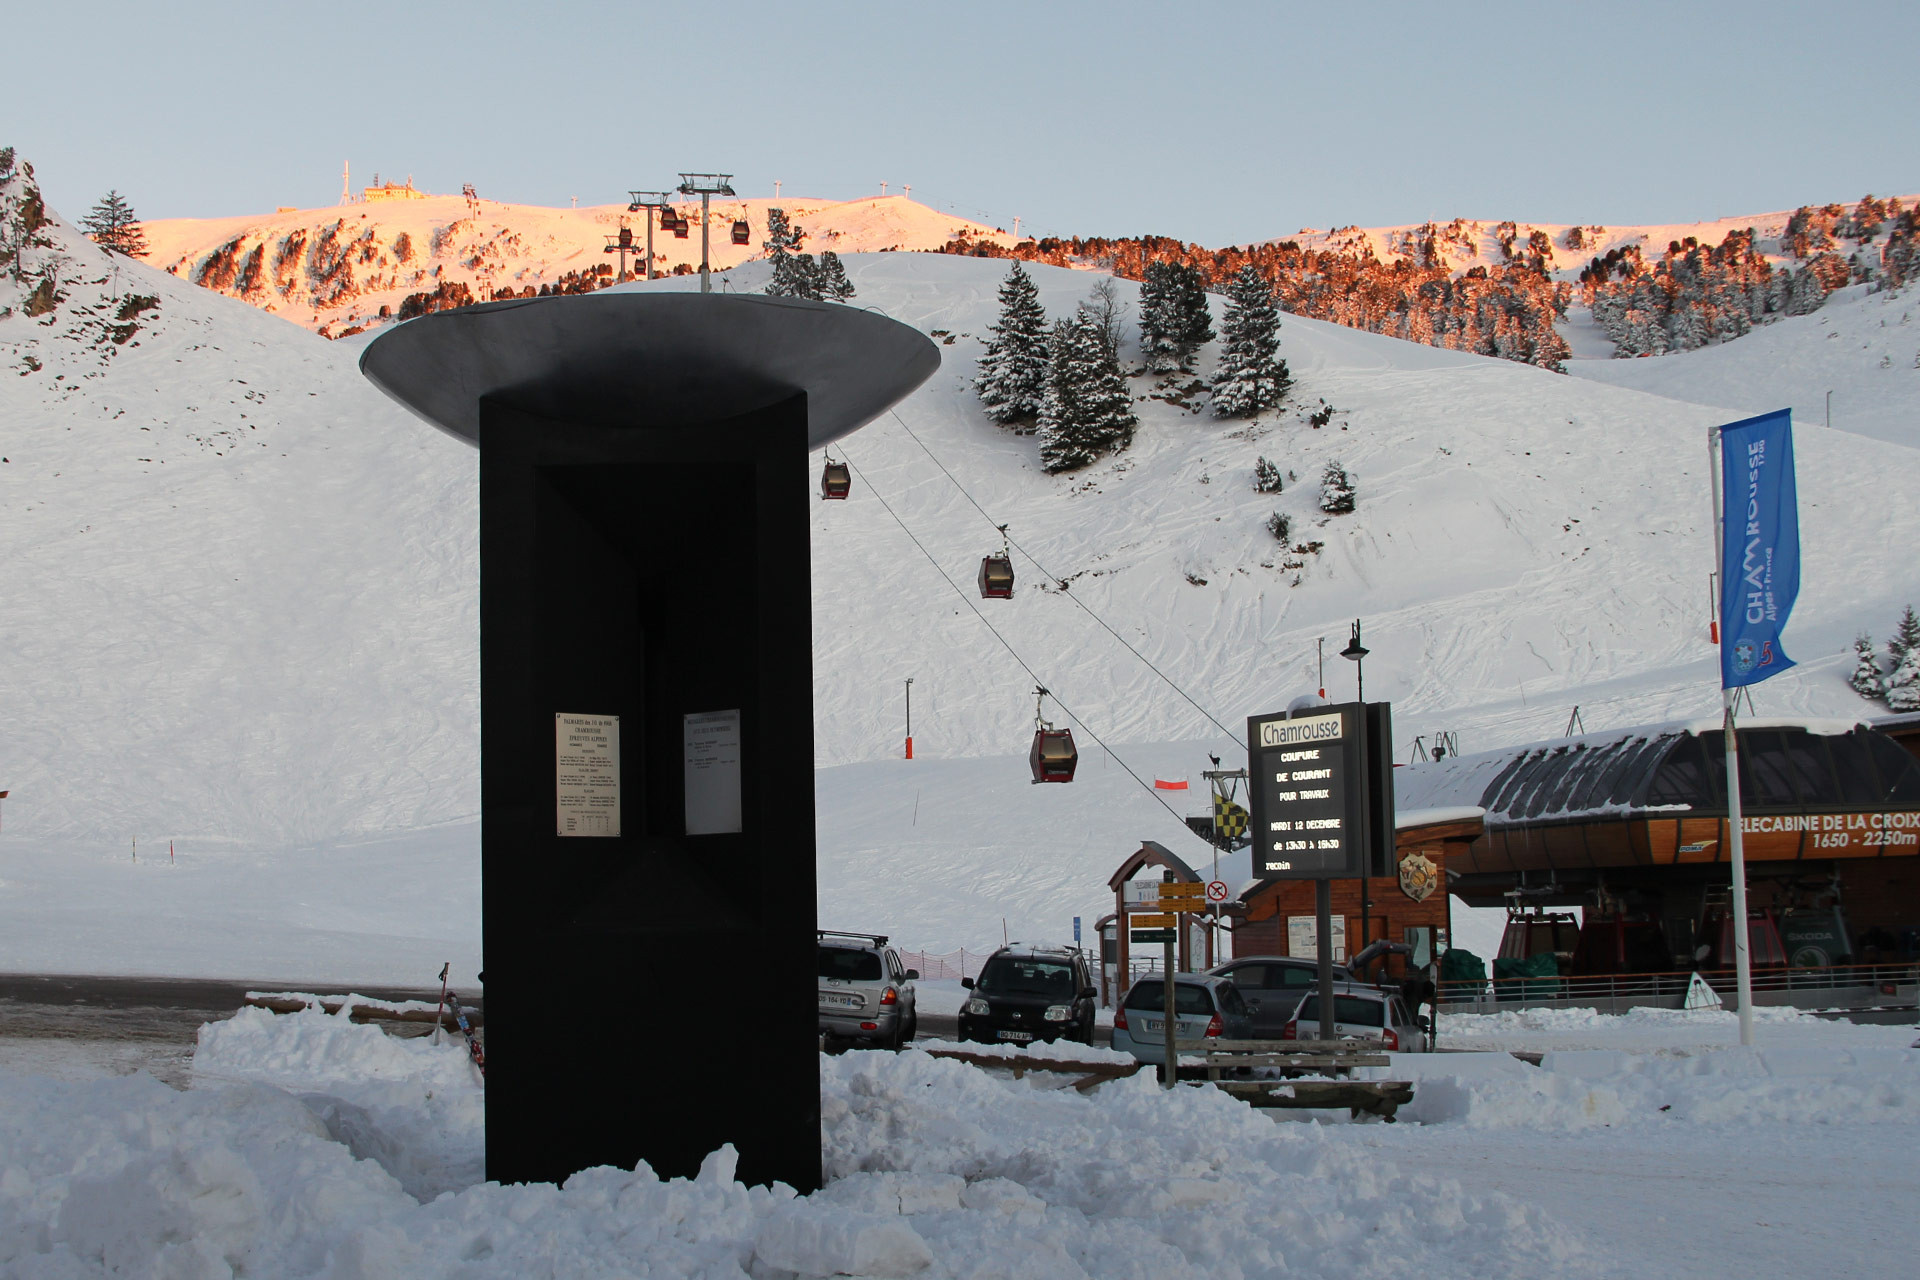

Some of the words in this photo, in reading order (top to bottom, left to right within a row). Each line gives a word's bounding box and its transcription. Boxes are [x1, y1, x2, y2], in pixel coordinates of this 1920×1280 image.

[1743, 441, 1764, 625] CHAMROUSSE
[1764, 547, 1773, 584] France
[1765, 591, 1777, 621] Alpes
[1263, 720, 1339, 744] Chamrousse
[1280, 749, 1320, 763] COUPURE
[1276, 772, 1289, 783] DE
[1292, 768, 1331, 781] COURANT
[1279, 791, 1297, 801] POUR
[1299, 789, 1329, 800] TRAVAUX
[1270, 821, 1291, 831] MARDI
[1295, 820, 1304, 830] 12
[1306, 818, 1340, 830] DECEMBRE
[1728, 815, 1818, 832] LECABINE
[1823, 815, 1843, 830] DE
[1847, 814, 1867, 829] LA
[1870, 813, 1920, 829] CROIX
[1273, 841, 1283, 851] de
[1285, 840, 1306, 850] 13h30
[1813, 832, 1848, 848] 1650
[1862, 830, 1917, 846] 2250m
[1265, 861, 1290, 871] recoin
